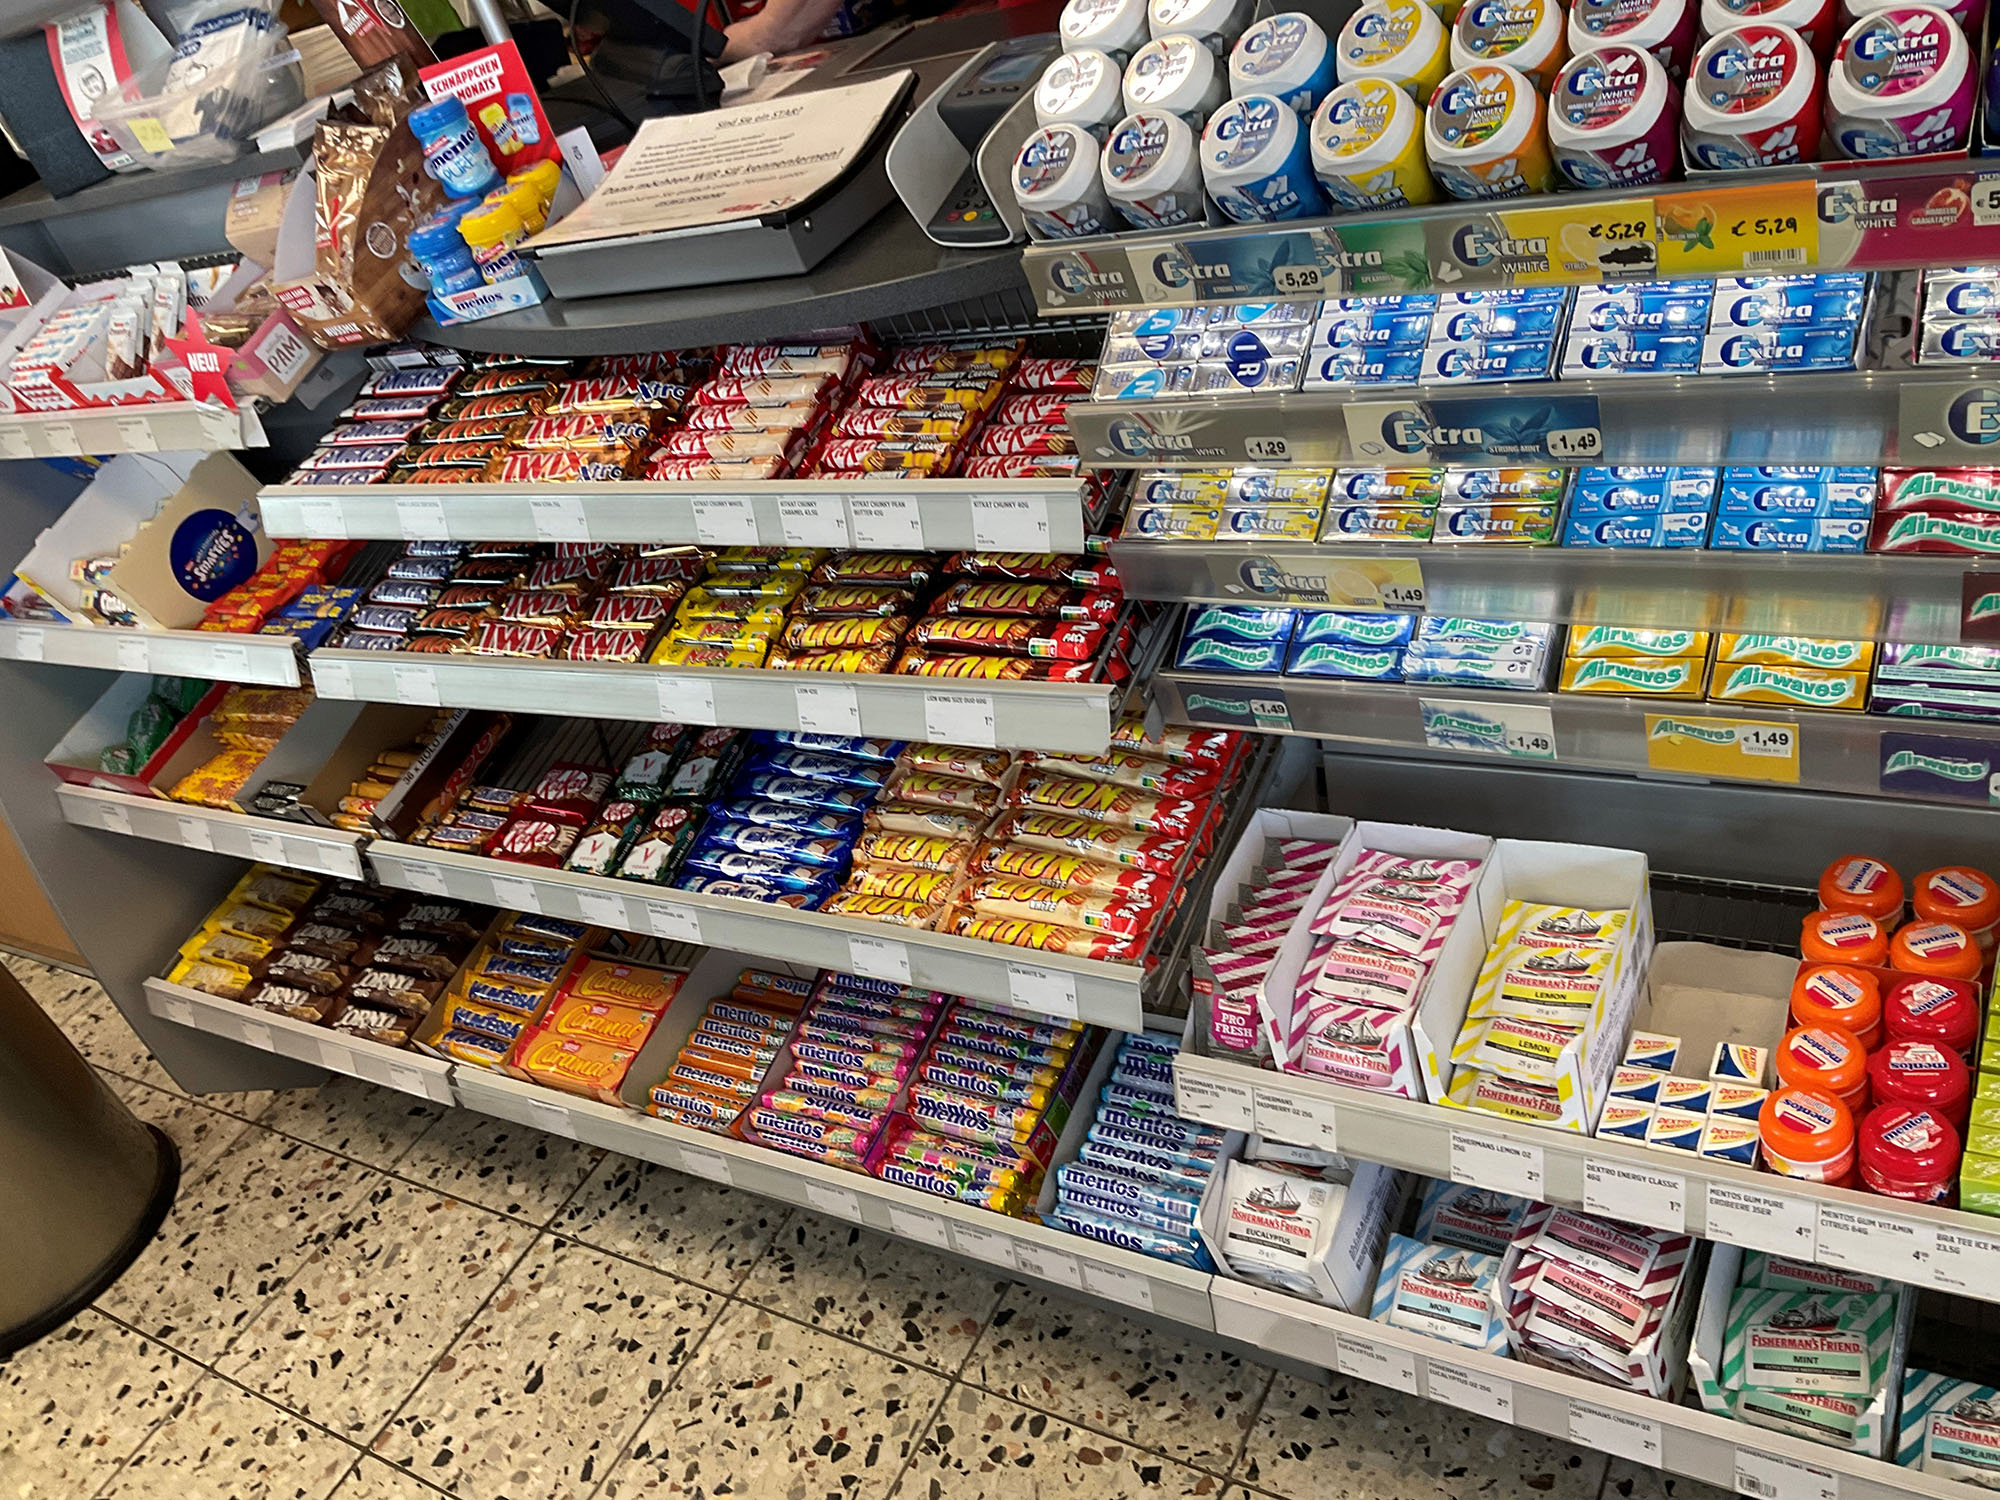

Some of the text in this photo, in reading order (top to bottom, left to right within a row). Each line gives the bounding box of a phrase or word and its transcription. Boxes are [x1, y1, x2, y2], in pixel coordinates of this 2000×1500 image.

[1360, 18, 1412, 37] Extra
[1866, 32, 1938, 54] Extra
[1718, 52, 1785, 73] Extra
[1898, 50, 1938, 62] WHITE
[431, 60, 498, 96] SCHNÄPPCHEN
[1577, 72, 1638, 87] Extra
[1744, 71, 1783, 82] WHITE
[456, 80, 496, 100] MONATS
[1451, 90, 1507, 109] Extra
[1601, 89, 1635, 100] WHITE
[1335, 103, 1387, 124] Extra
[1473, 106, 1504, 117] WHITE
[1222, 118, 1272, 140] Extra
[1118, 132, 1166, 154] Extra
[1824, 195, 1897, 213] Extra
[1755, 218, 1797, 235] 5,29
[1854, 216, 1896, 229] WHITE
[1465, 234, 1547, 258] Extra
[1061, 267, 1123, 287] Extra
[1163, 261, 1230, 281] Extra
[1502, 261, 1549, 272] WHITE
[1279, 271, 1318, 287] €5,29
[456, 292, 503, 312] mentos
[1094, 289, 1128, 299] WHITE
[187, 353, 221, 372] NEU!
[268, 333, 303, 373] PAM
[730, 346, 778, 377] KitKat
[1023, 359, 1075, 387] KitKat
[559, 379, 639, 413] TWIX
[862, 379, 919, 406] KitKat
[526, 415, 612, 448] TWIX
[841, 408, 895, 435] KitKat
[981, 425, 1048, 455] KitKat
[1118, 429, 1192, 449] Extra
[1395, 421, 1482, 446] Extra
[824, 440, 877, 468] KitKat
[1196, 448, 1225, 456] WHITE
[502, 451, 587, 483] TWIX
[841, 555, 912, 576] LION
[503, 592, 588, 621] TWIX
[962, 583, 1044, 609] LION
[592, 597, 671, 626] TWIX
[1199, 610, 1276, 634] Airwaves
[480, 621, 563, 654] TWIX
[804, 618, 880, 648] LION
[928, 617, 1011, 641] LION
[566, 630, 648, 660] TWIX
[1193, 639, 1268, 664] Airwaves
[1302, 644, 1389, 672] Airwaves
[1582, 660, 1681, 686] Airwaves
[1729, 667, 1845, 698] Airwaves
[1188, 696, 1247, 714] Airwaves
[1434, 715, 1502, 736] Airwaves
[1655, 720, 1735, 742] Airwaves
[1743, 730, 1789, 747] €1,49
[1889, 752, 1982, 776] Airwaves
[1037, 783, 1127, 814] LION
[874, 835, 947, 866] LION
[998, 849, 1083, 884] LION
[1329, 952, 1416, 978] FISHERMAN'S FRIEND
[1345, 967, 1390, 982] RASPBERRY
[836, 973, 899, 995] mentos
[1505, 973, 1565, 990] FISHERMAN'S
[1535, 991, 1567, 1000] LEMON
[557, 1003, 646, 1040] Caramac
[713, 1005, 770, 1027] mentos
[1221, 1012, 1246, 1027] PRO
[704, 1020, 761, 1041] mentos
[1216, 1021, 1253, 1038] FRESH
[799, 1046, 864, 1068] mentos
[1307, 1044, 1361, 1068] FISHERMAN'S
[1518, 1039, 1551, 1054] LEMON
[528, 1040, 615, 1079] Caramac
[675, 1066, 733, 1088] mentos
[1324, 1064, 1371, 1082] RASPBERRY
[655, 1090, 712, 1115] mentos
[757, 1113, 823, 1138] mentos
[885, 1165, 957, 1196] mentos
[1587, 1164, 1678, 1190] DEXTRO ENERGY CLASSIC
[1710, 1188, 1784, 1209] MENTOS GUM PURE
[1281, 1221, 1312, 1238] FRIEND
[1821, 1209, 1913, 1235] MENTOS GUM VITAMIN
[1821, 1219, 1850, 1233] CITRUS
[1246, 1228, 1291, 1245] EUCALYPTUS
[1578, 1235, 1612, 1253] CHERRY
[1612, 1234, 1649, 1256] FRIEND
[1956, 1236, 1973, 1247] TEE
[1455, 1290, 1487, 1310] FRIEND
[1562, 1275, 1623, 1310] CHAOS QUEEN
[1429, 1302, 1451, 1314] MOIN
[1752, 1334, 1860, 1353] FISHERMAN'S FRIEND
[1793, 1355, 1818, 1364] MINT
[1786, 1403, 1812, 1418] MINT
